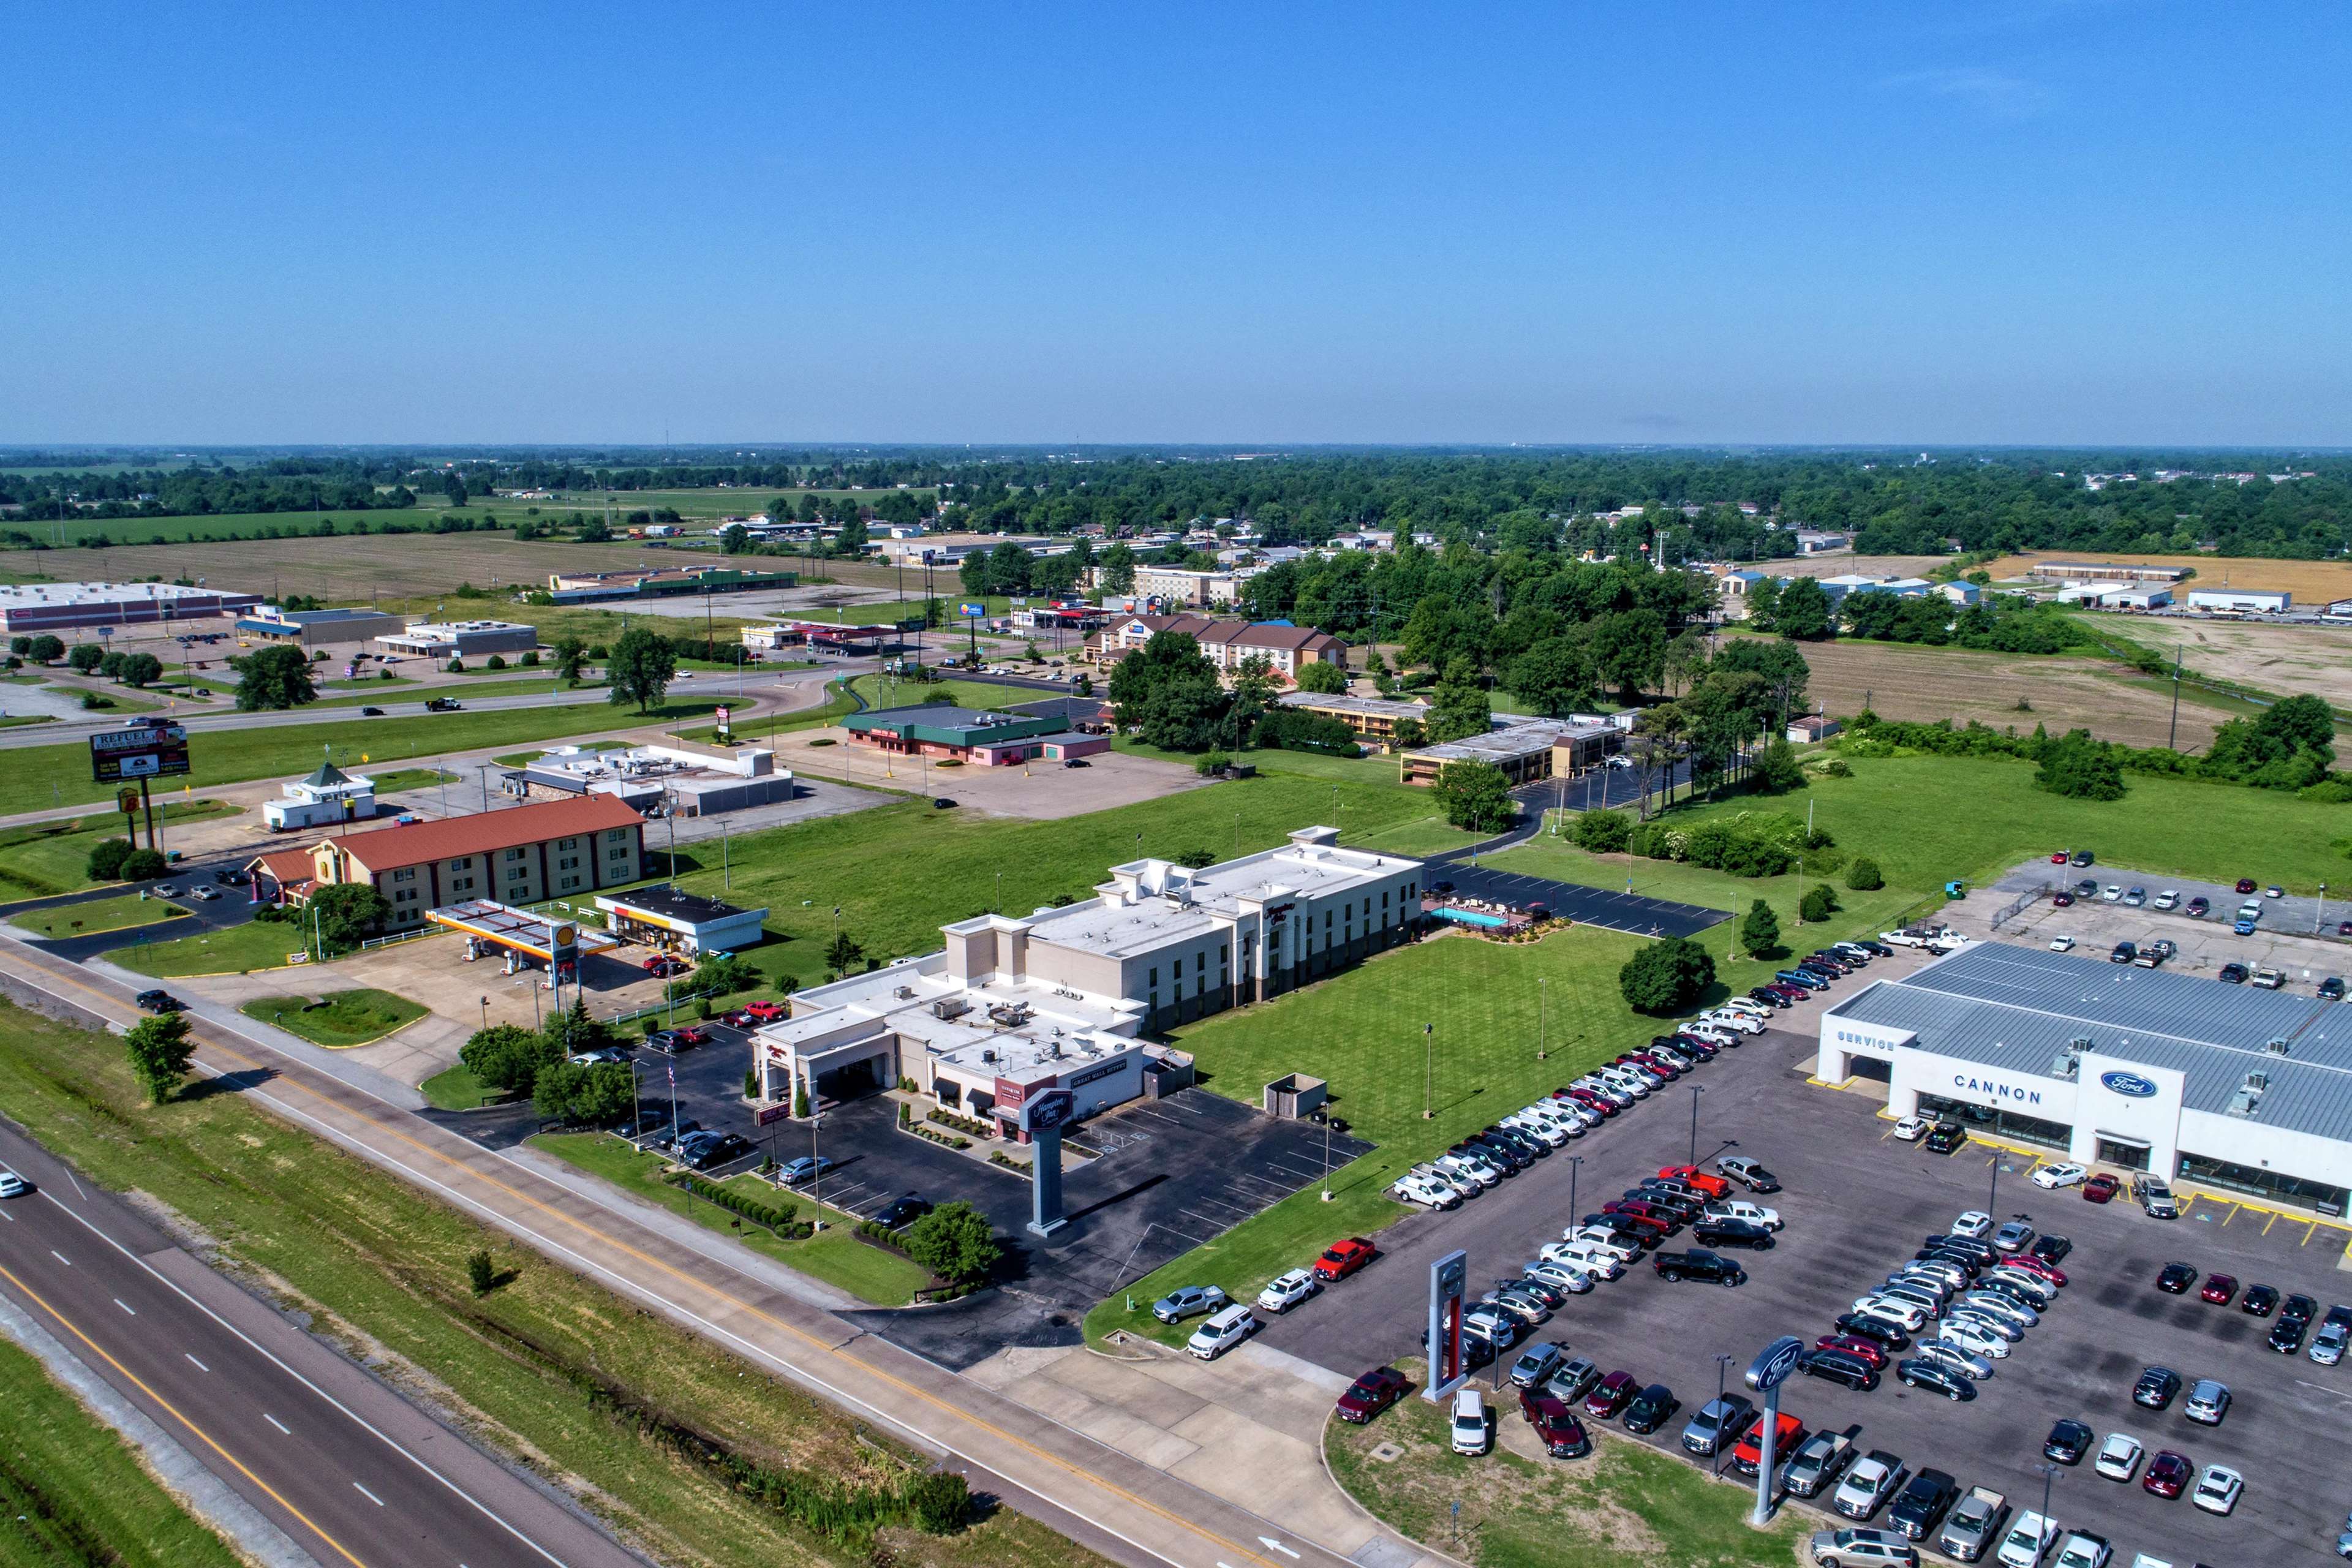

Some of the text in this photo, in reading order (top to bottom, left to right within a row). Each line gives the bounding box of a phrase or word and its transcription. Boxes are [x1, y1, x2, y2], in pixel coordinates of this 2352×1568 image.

[100, 732, 149, 744] REFUEL
[1838, 1031, 1894, 1051] SERVICE
[1074, 1076, 1091, 1086] GREAT
[1954, 1075, 2040, 1103] CANNON
[2112, 1076, 2145, 1092] Ford
[1034, 1098, 1066, 1118] Hampton
[1042, 1109, 1059, 1122] Inn
[1767, 1351, 1796, 1385] Ford
